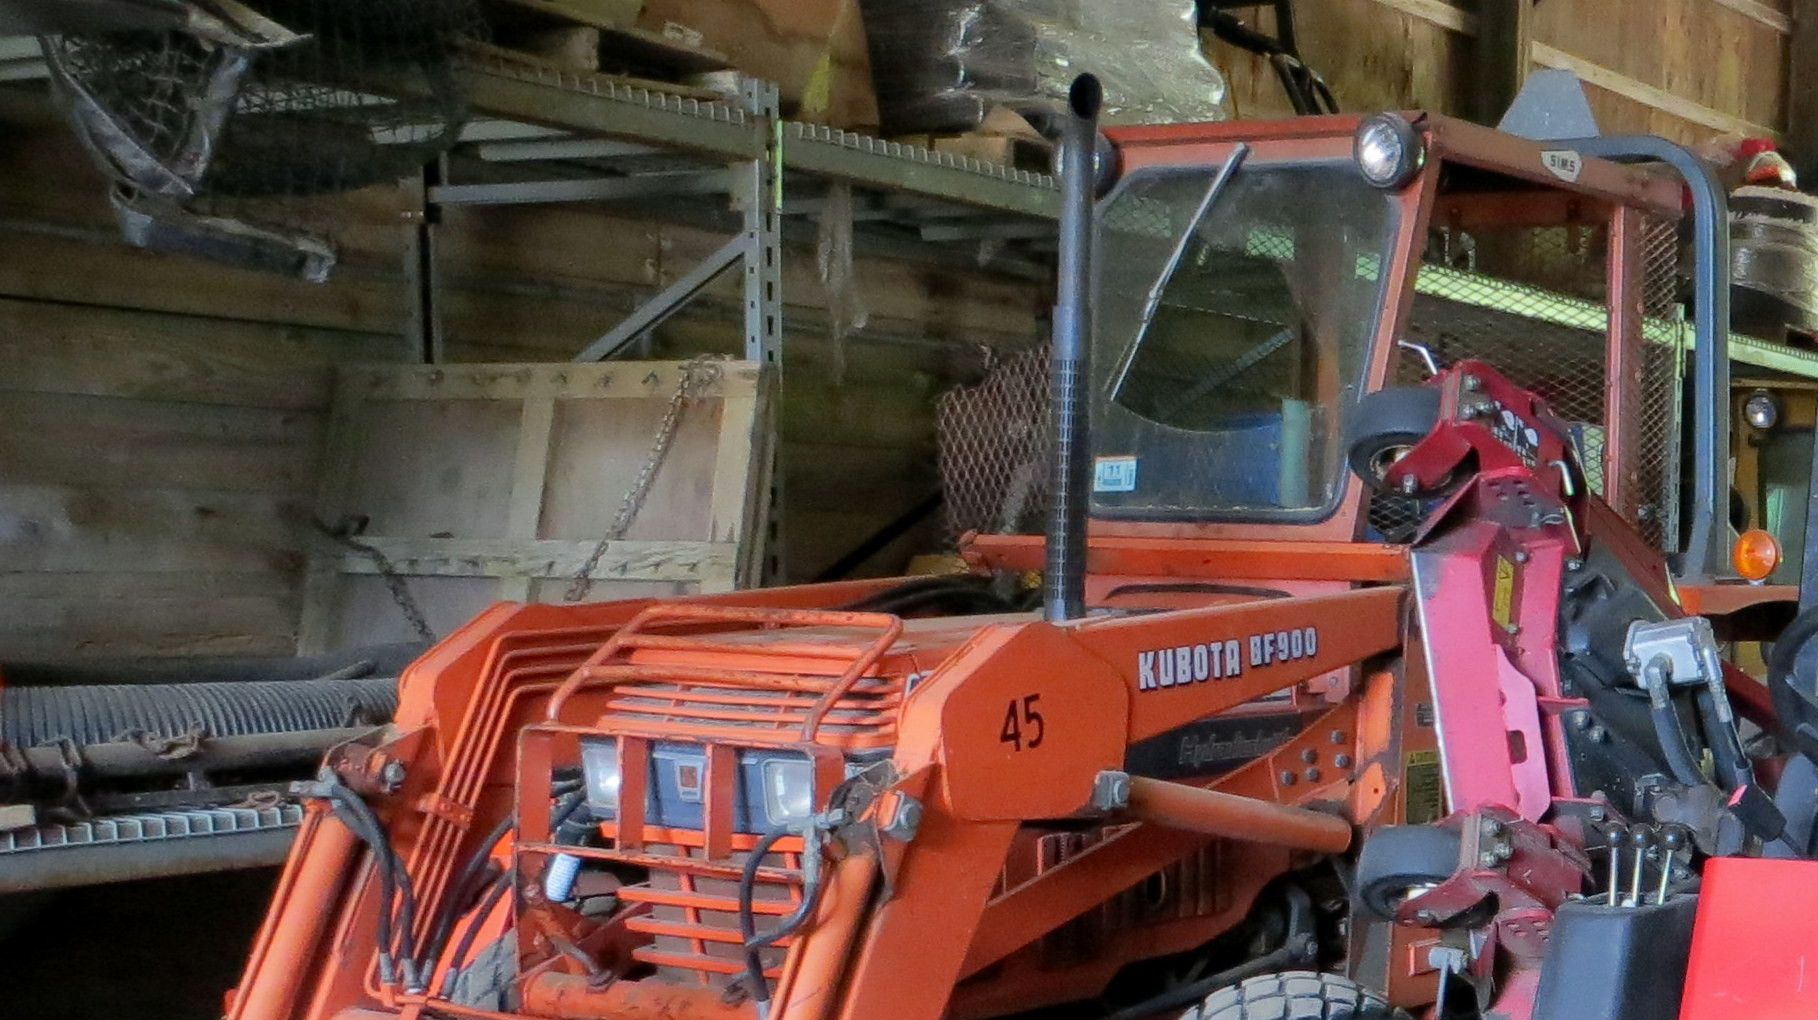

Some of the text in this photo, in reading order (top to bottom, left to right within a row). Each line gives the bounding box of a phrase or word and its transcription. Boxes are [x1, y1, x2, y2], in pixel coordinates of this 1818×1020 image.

[1550, 154, 1575, 173] SIMS
[1137, 626, 1319, 692] KUBOTA BF900
[999, 692, 1045, 753] 45
